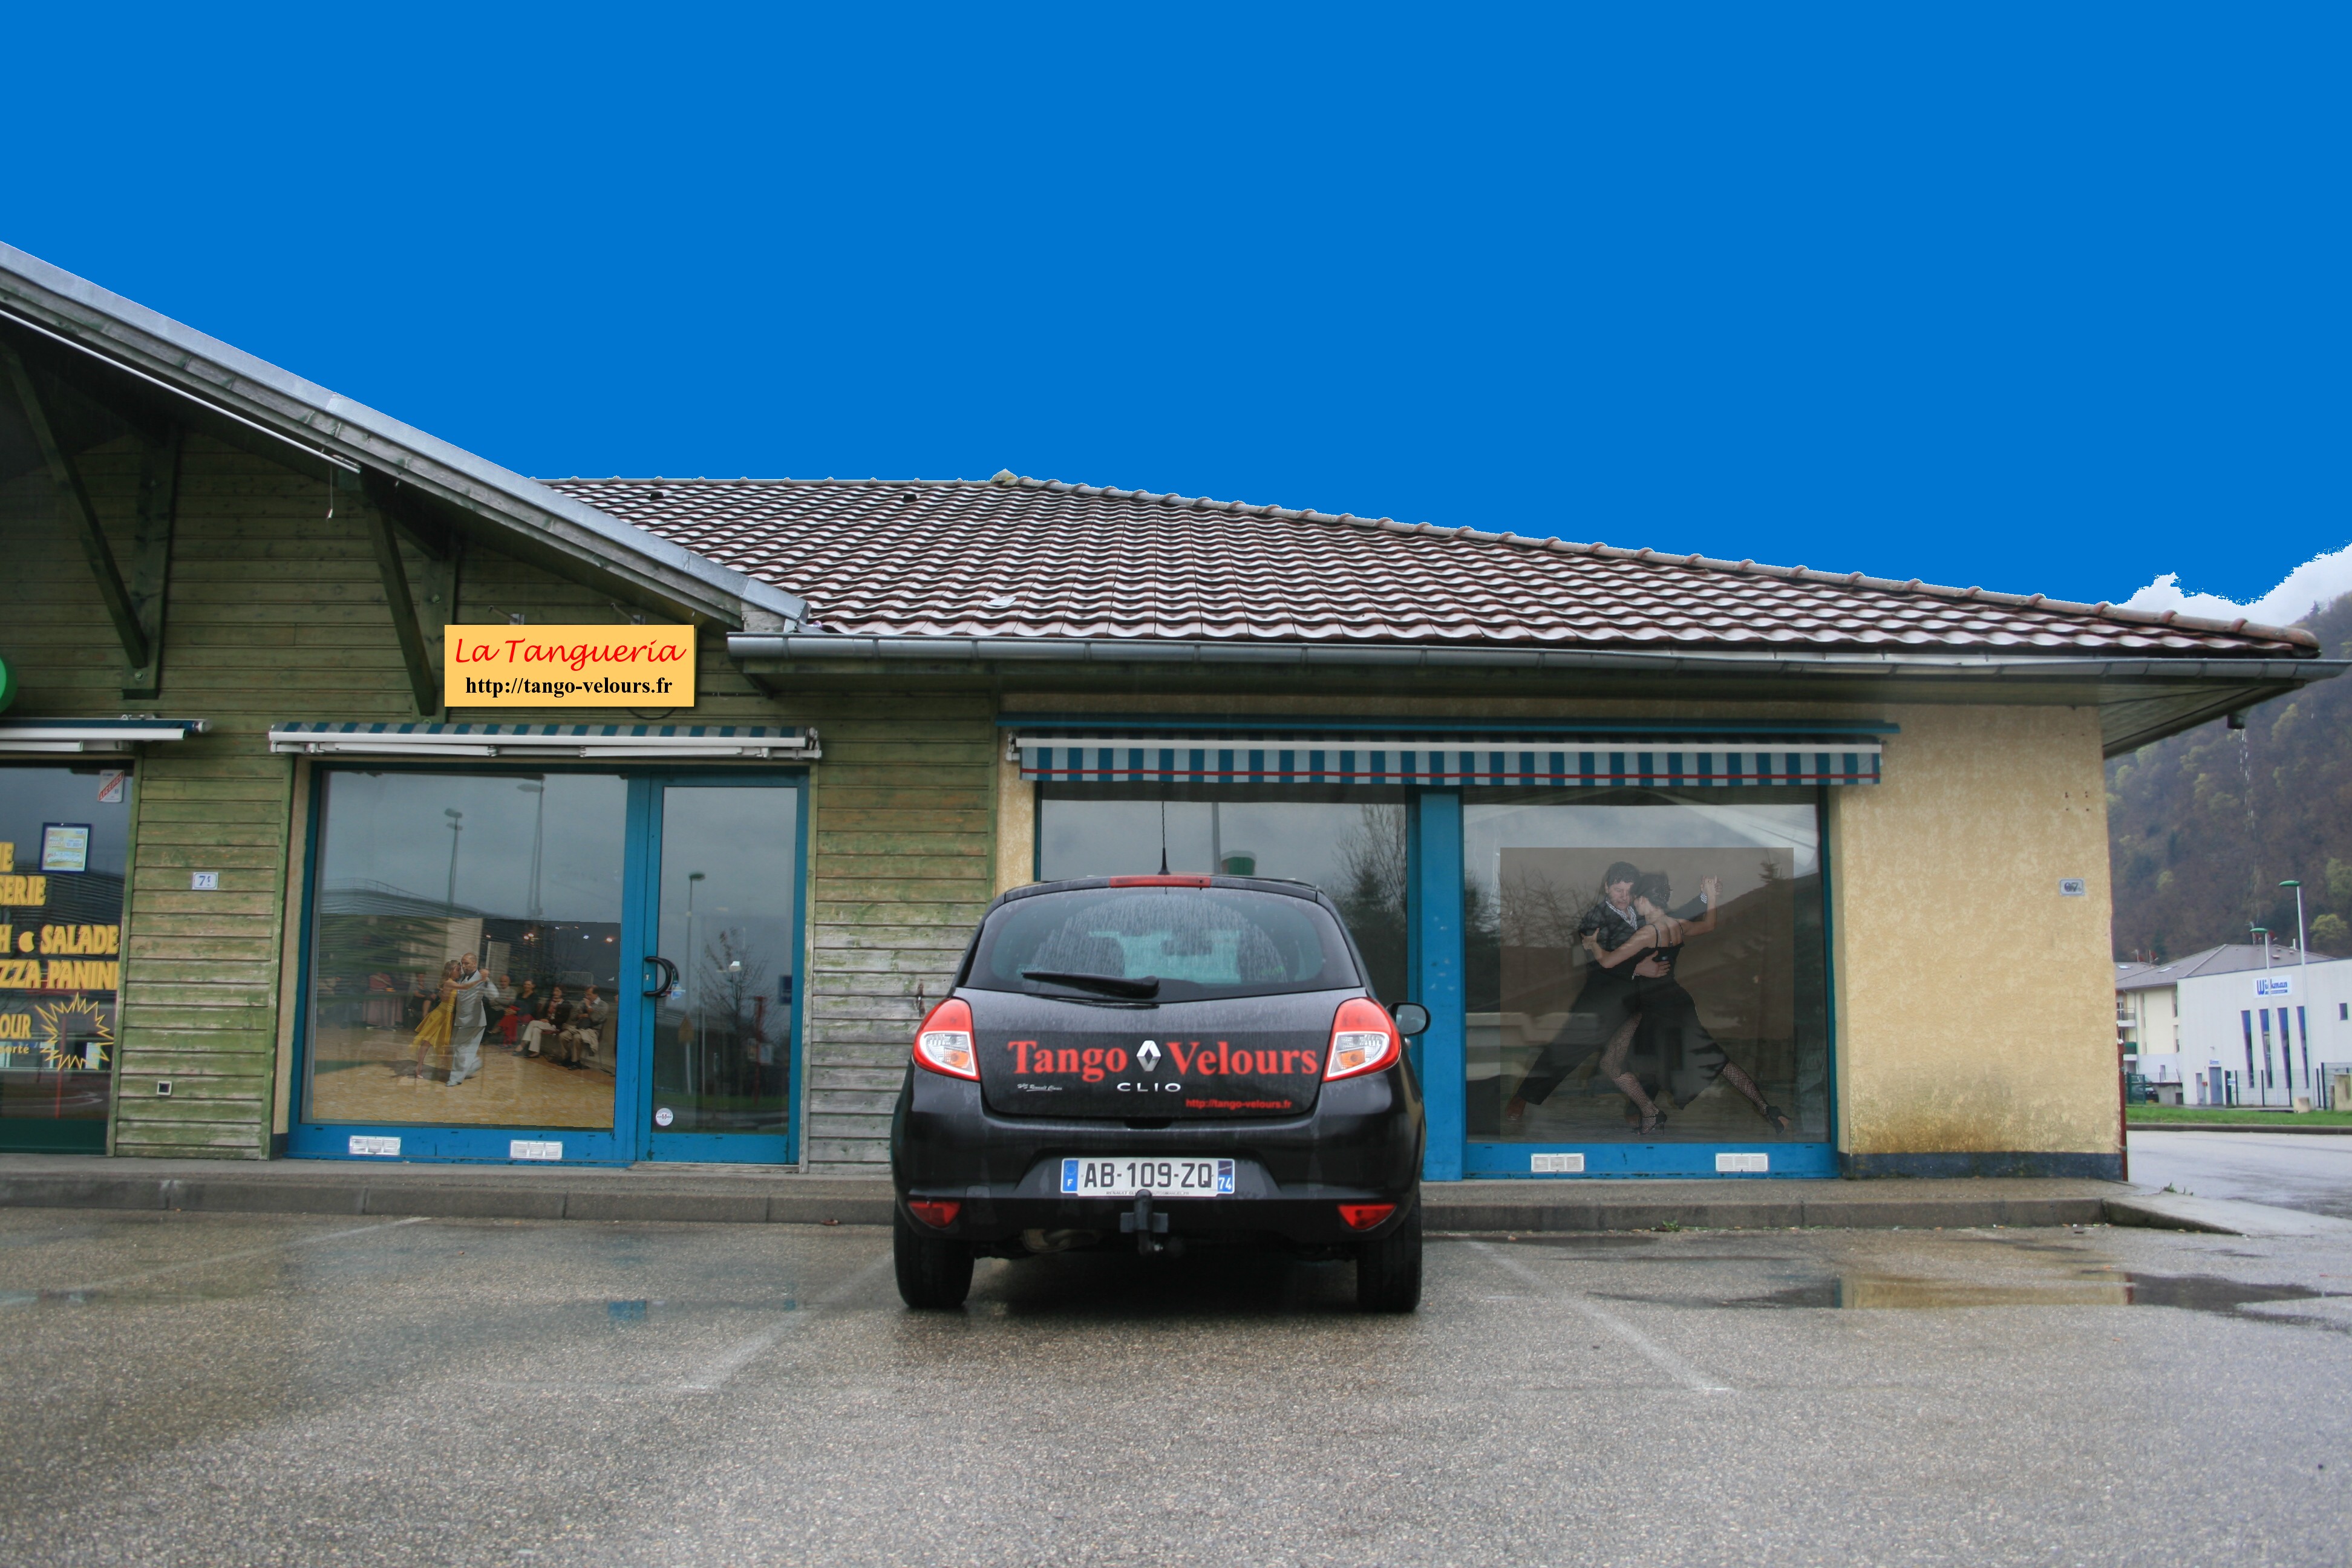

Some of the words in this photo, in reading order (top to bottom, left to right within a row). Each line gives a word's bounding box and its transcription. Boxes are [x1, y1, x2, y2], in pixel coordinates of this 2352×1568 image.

[456, 638, 500, 663] La
[465, 678, 673, 698] http://tango-velours.fr
[40, 924, 119, 955] SALADE
[46, 960, 119, 990] PANINI
[1007, 1040, 1128, 1083] Tango
[1166, 1040, 1319, 1076] Velours
[1117, 1082, 1181, 1093] CLIO
[1186, 1098, 1293, 1111] http://tango-velours.fr
[1218, 1177, 1232, 1190] 74
